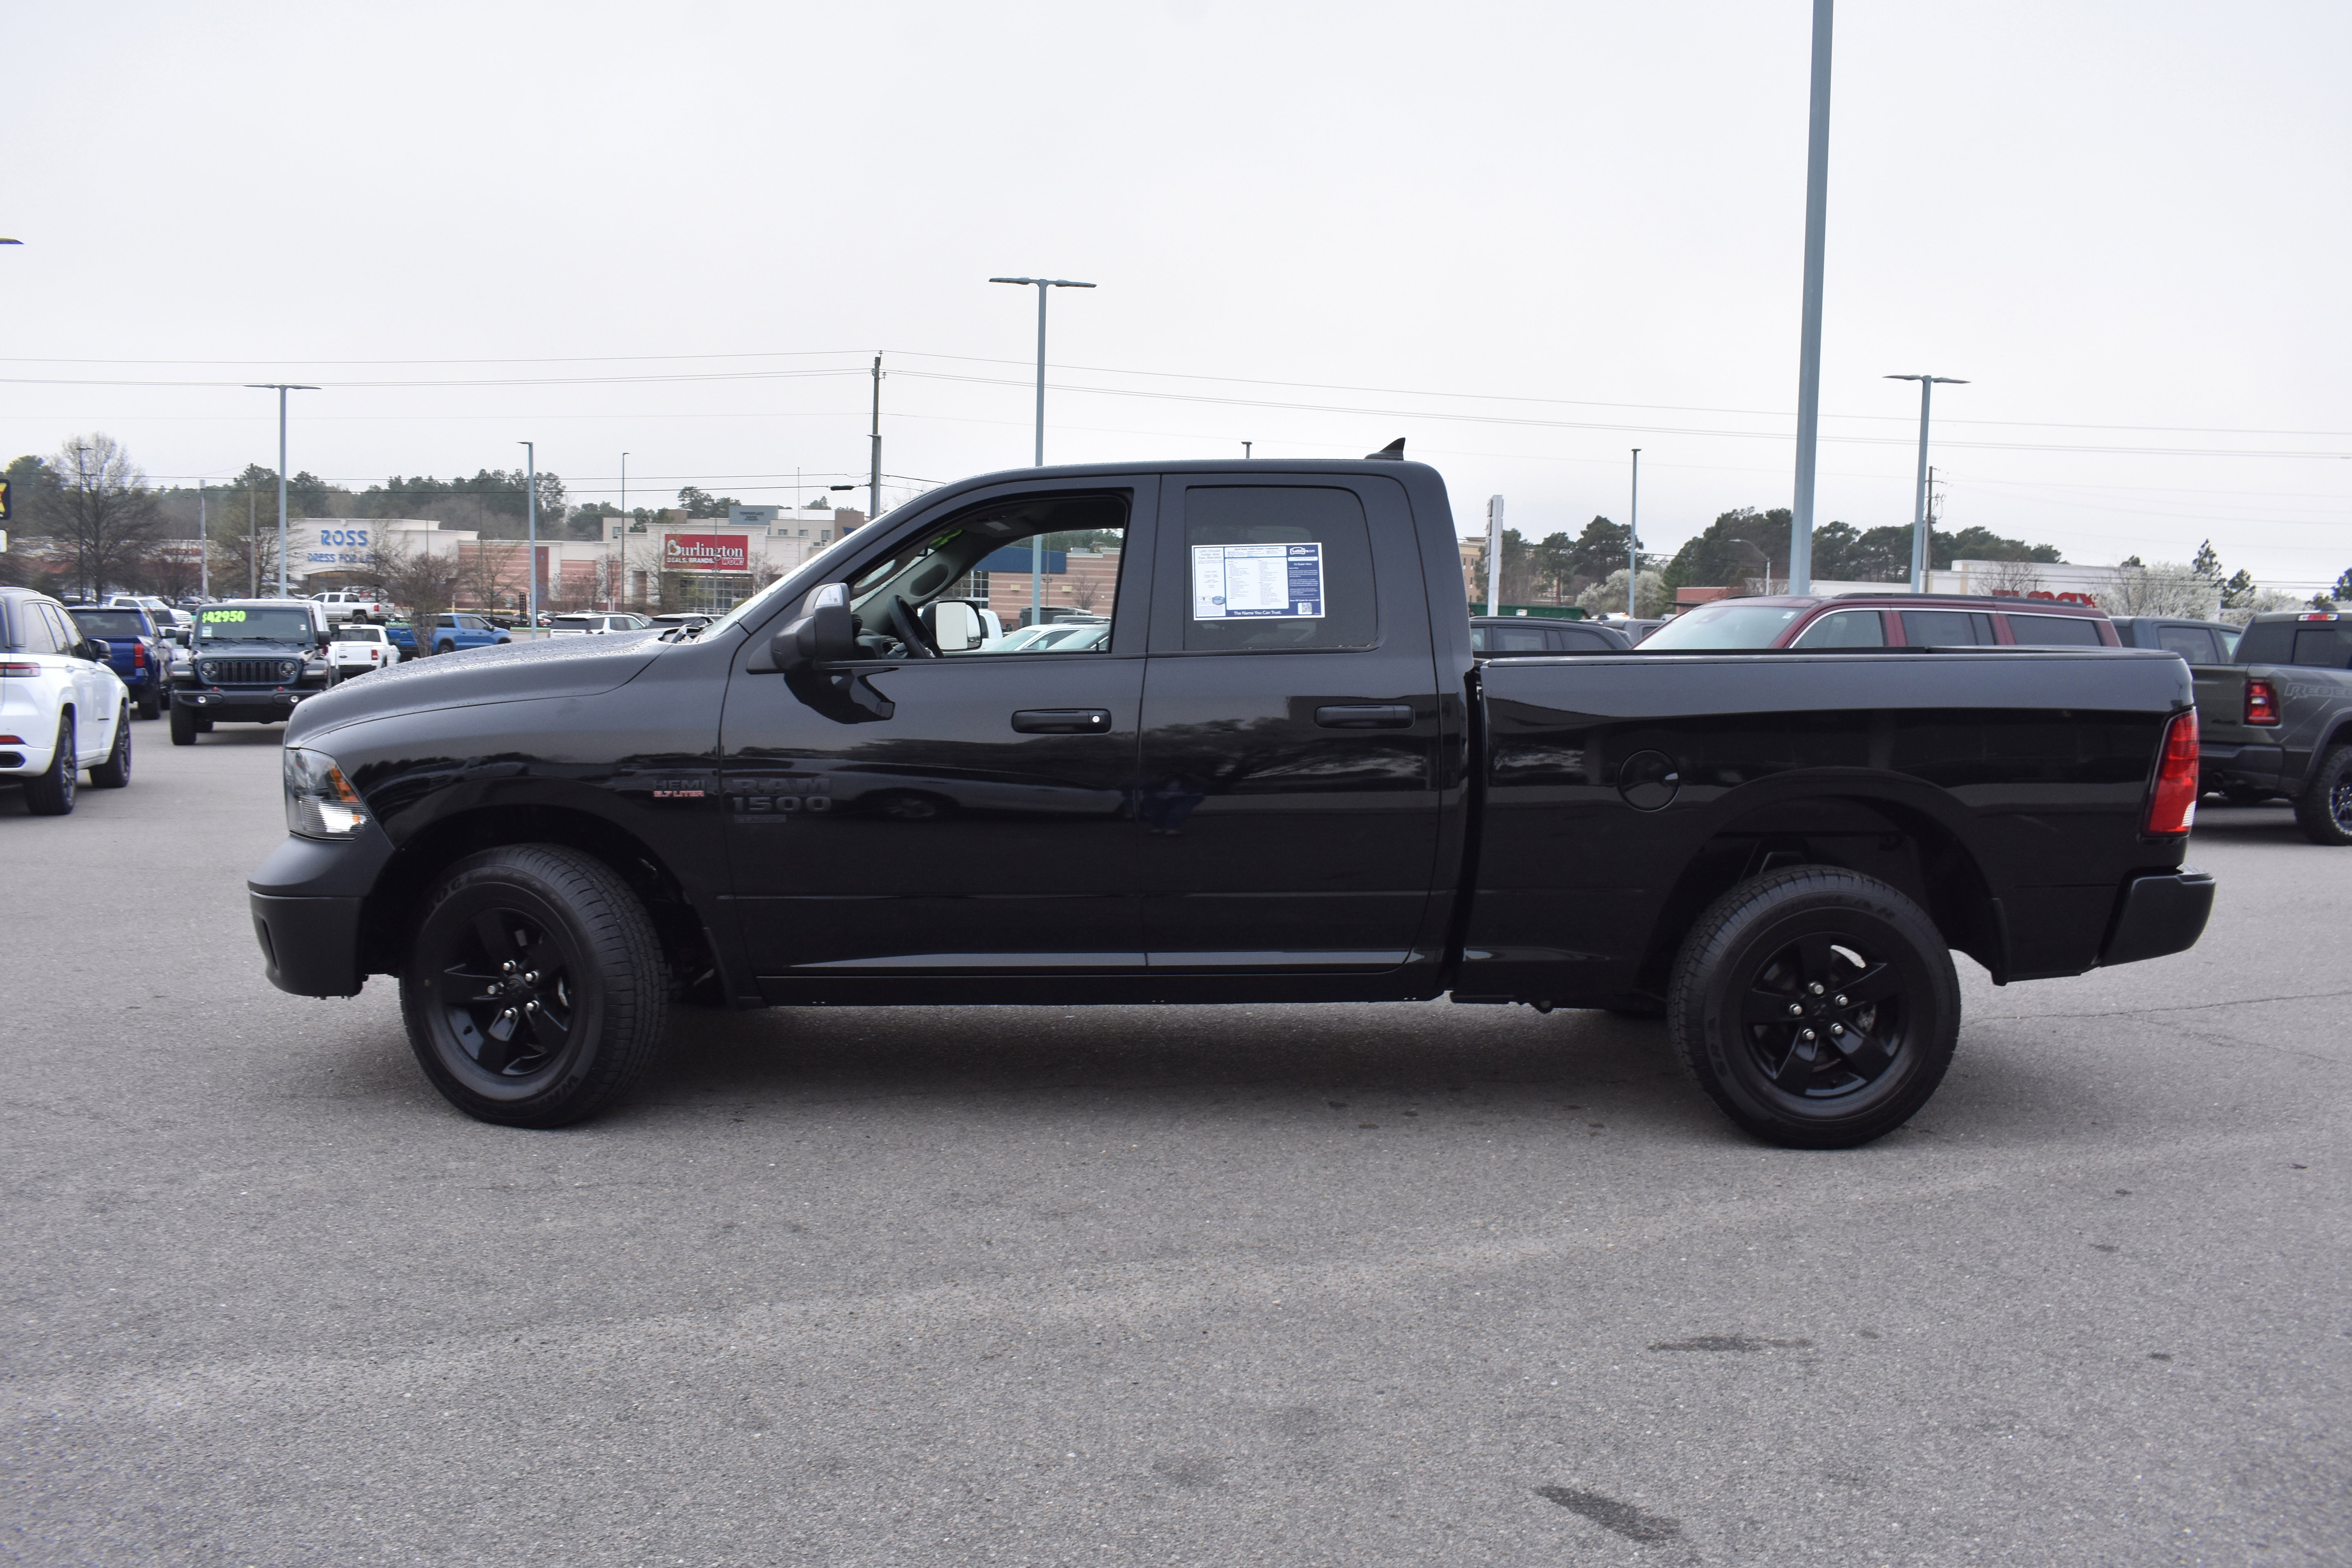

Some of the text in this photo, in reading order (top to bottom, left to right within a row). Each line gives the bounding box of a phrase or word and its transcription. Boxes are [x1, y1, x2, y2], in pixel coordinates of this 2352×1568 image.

[321, 530, 368, 546] ROSS
[667, 539, 744, 561] Burlington
[307, 553, 335, 563] DRESS
[339, 554, 356, 563] FOR
[722, 557, 744, 566] WOW!
[202, 610, 246, 624] $42950
[653, 780, 706, 789] HEMI
[733, 778, 830, 794] RAM
[733, 796, 831, 812] 1500
